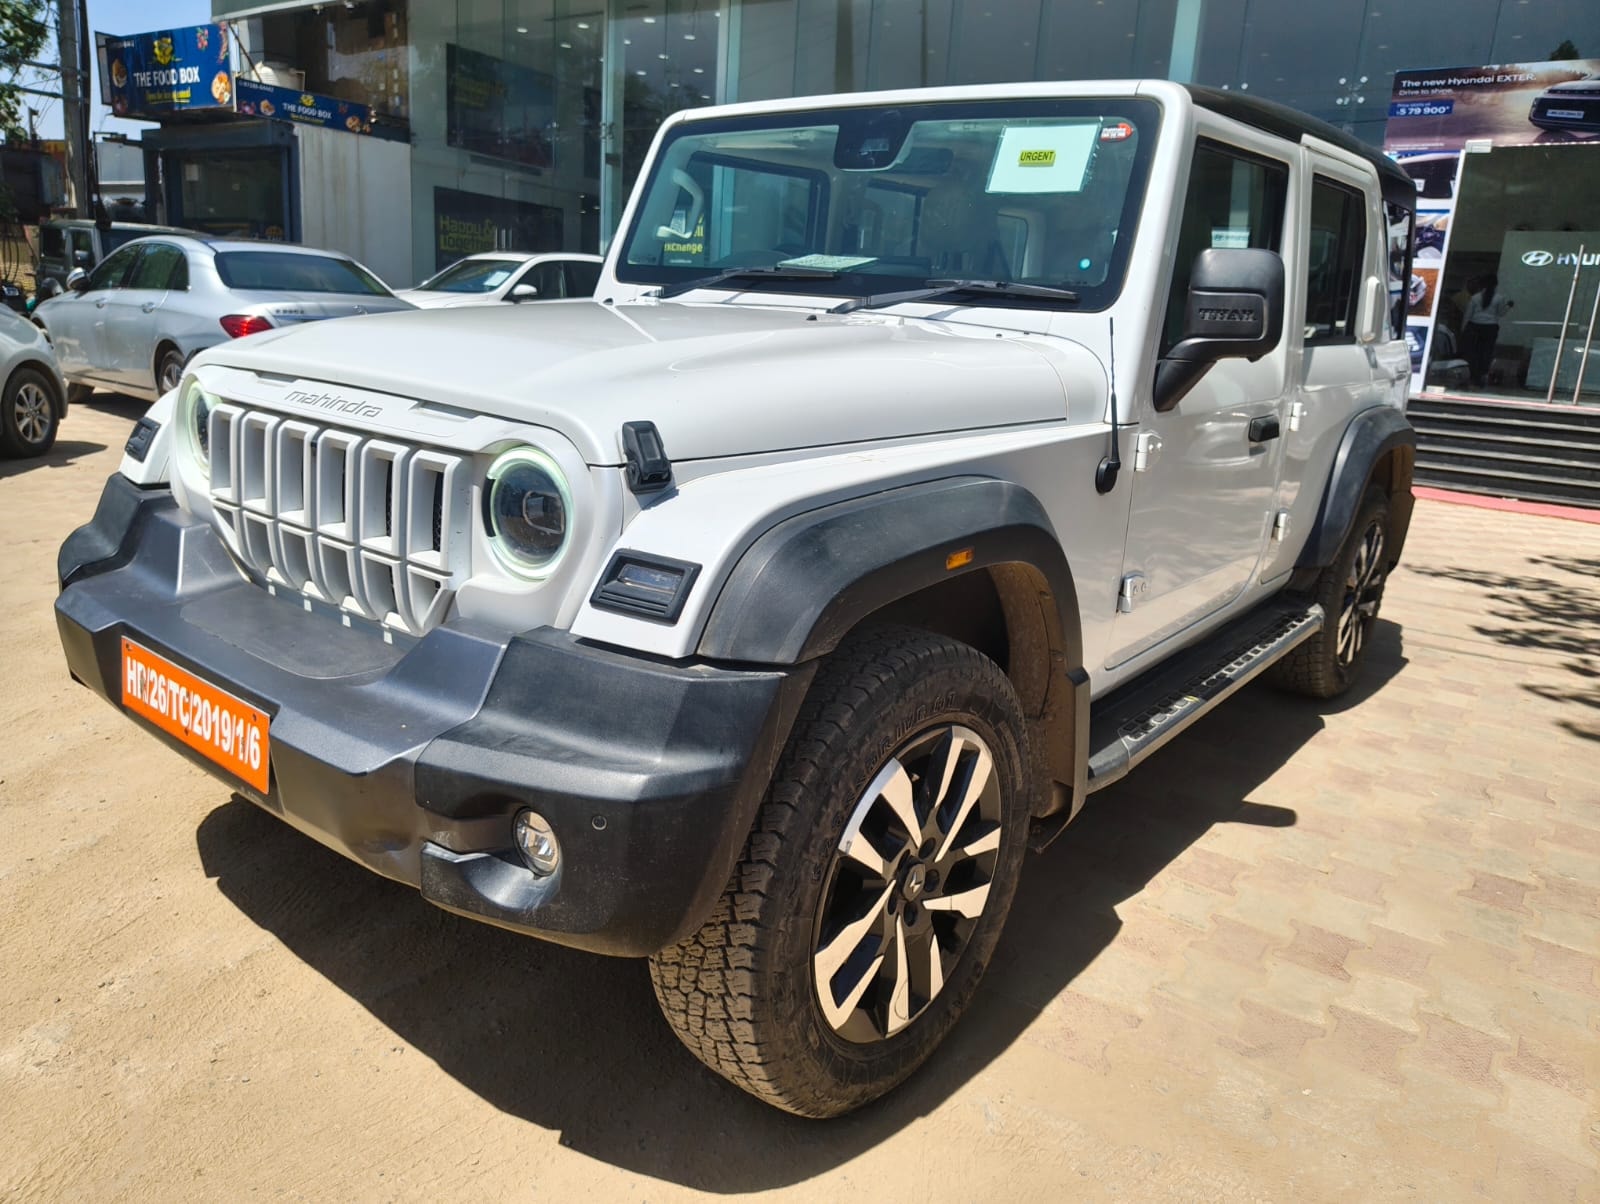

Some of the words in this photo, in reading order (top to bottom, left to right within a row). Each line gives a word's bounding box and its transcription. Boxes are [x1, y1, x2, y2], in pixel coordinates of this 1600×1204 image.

[133, 71, 152, 87] THE
[153, 68, 177, 86] FOOD
[179, 65, 200, 84] BOX
[1401, 79, 1421, 88] The
[1422, 78, 1447, 87] new
[1447, 75, 1495, 86] Hyundai
[282, 102, 297, 113] THE
[297, 105, 317, 117] FOOD
[317, 109, 332, 119] BOX
[1019, 150, 1055, 162] URGENT
[284, 390, 383, 418] mahindra
